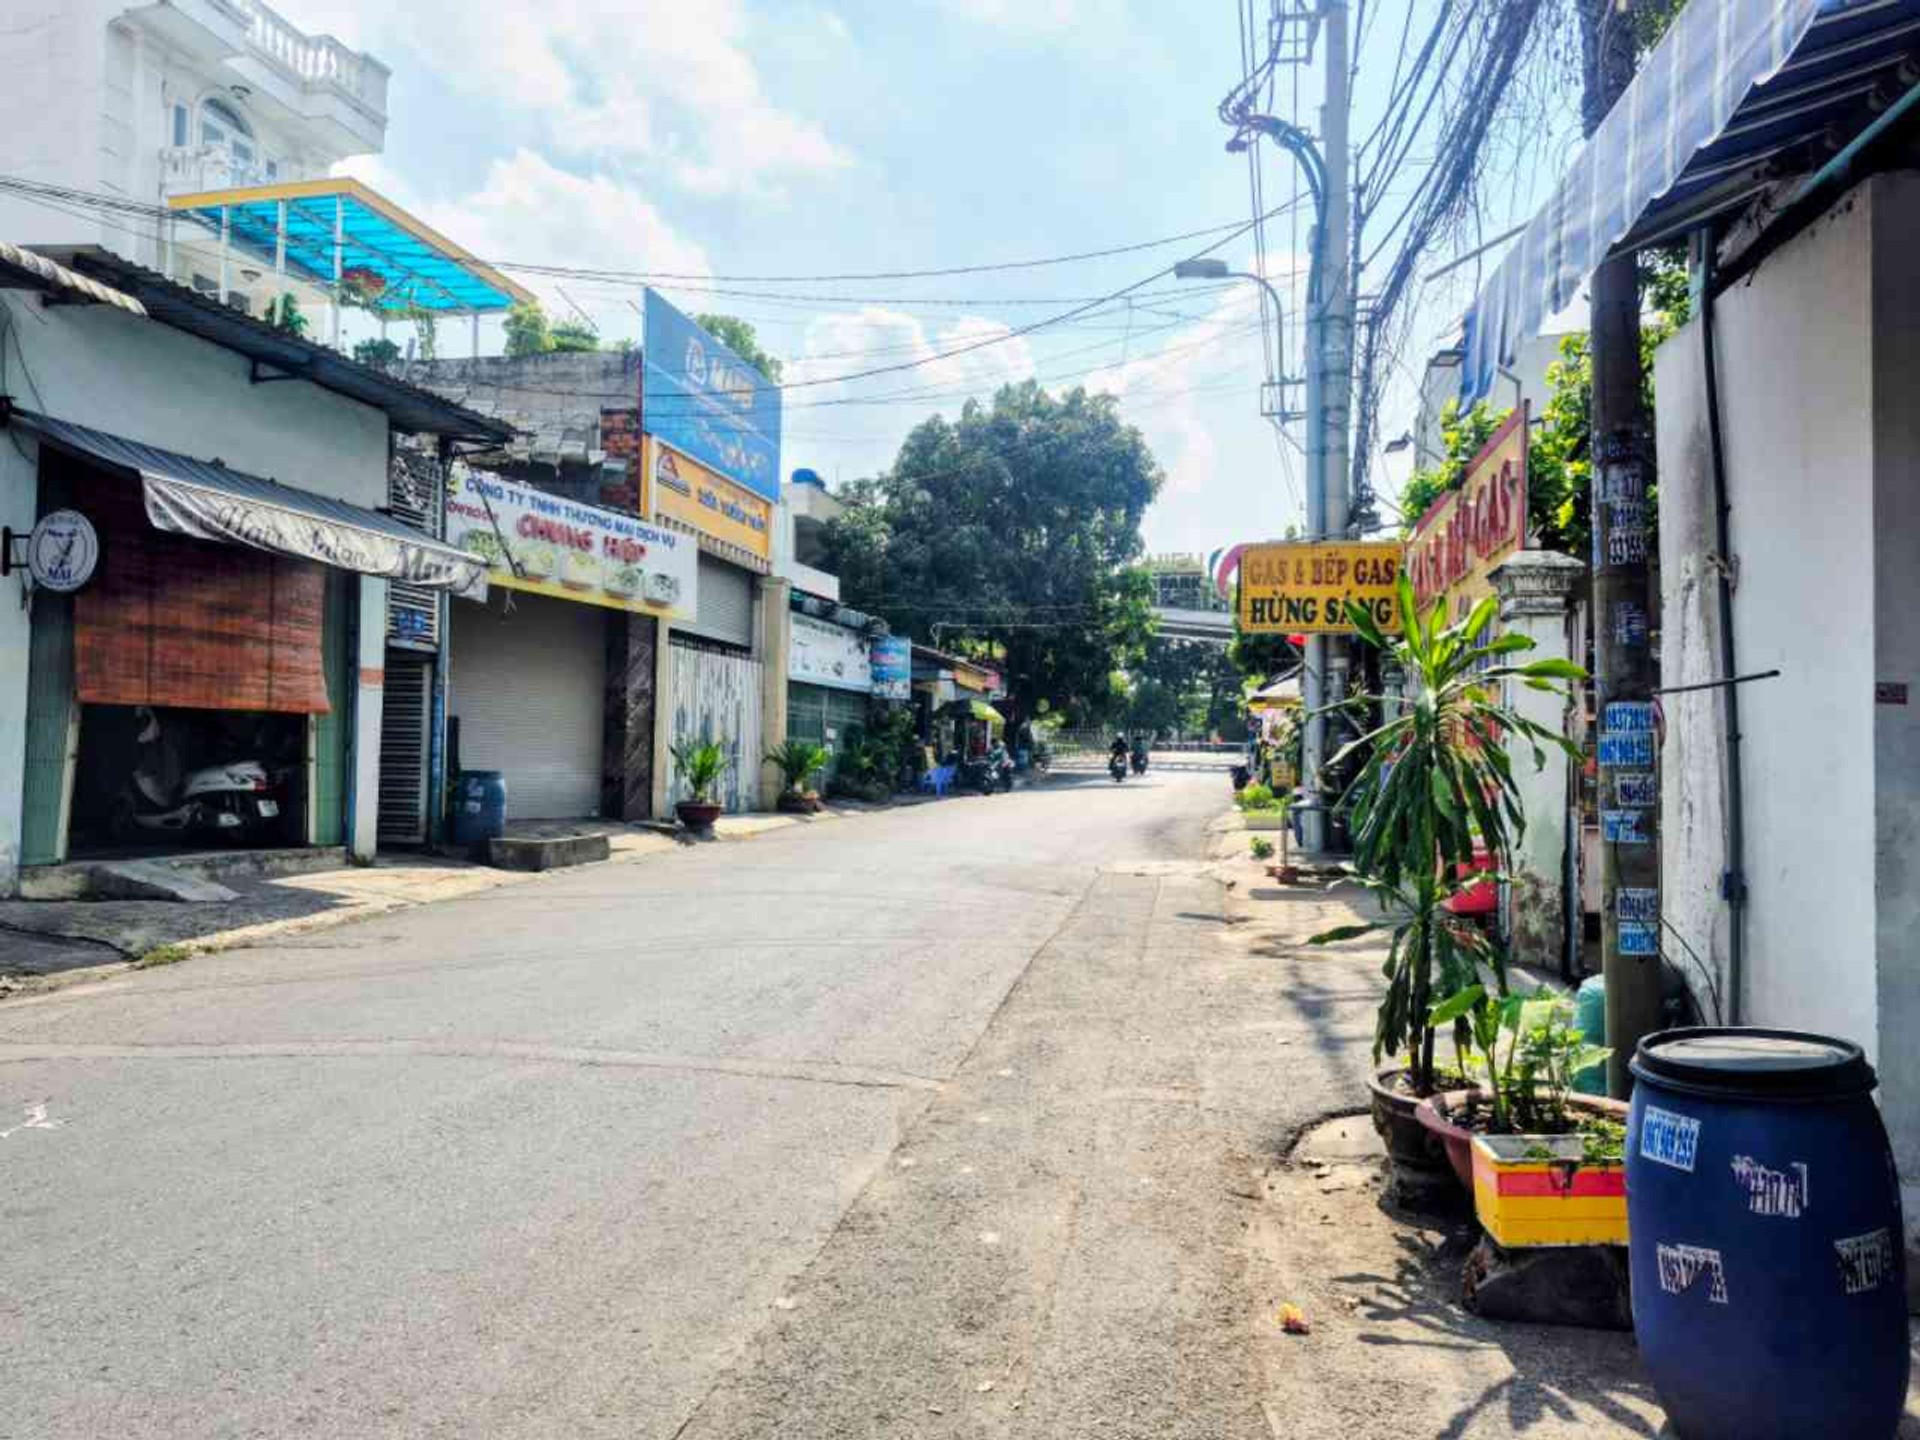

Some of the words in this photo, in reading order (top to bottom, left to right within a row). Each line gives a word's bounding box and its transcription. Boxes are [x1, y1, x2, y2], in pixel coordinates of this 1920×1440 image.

[508, 491, 525, 506] TY
[1474, 459, 1511, 560] GAS
[1250, 558, 1288, 585] GAS
[1310, 552, 1347, 586] BẾP
[1354, 558, 1396, 585] GAS
